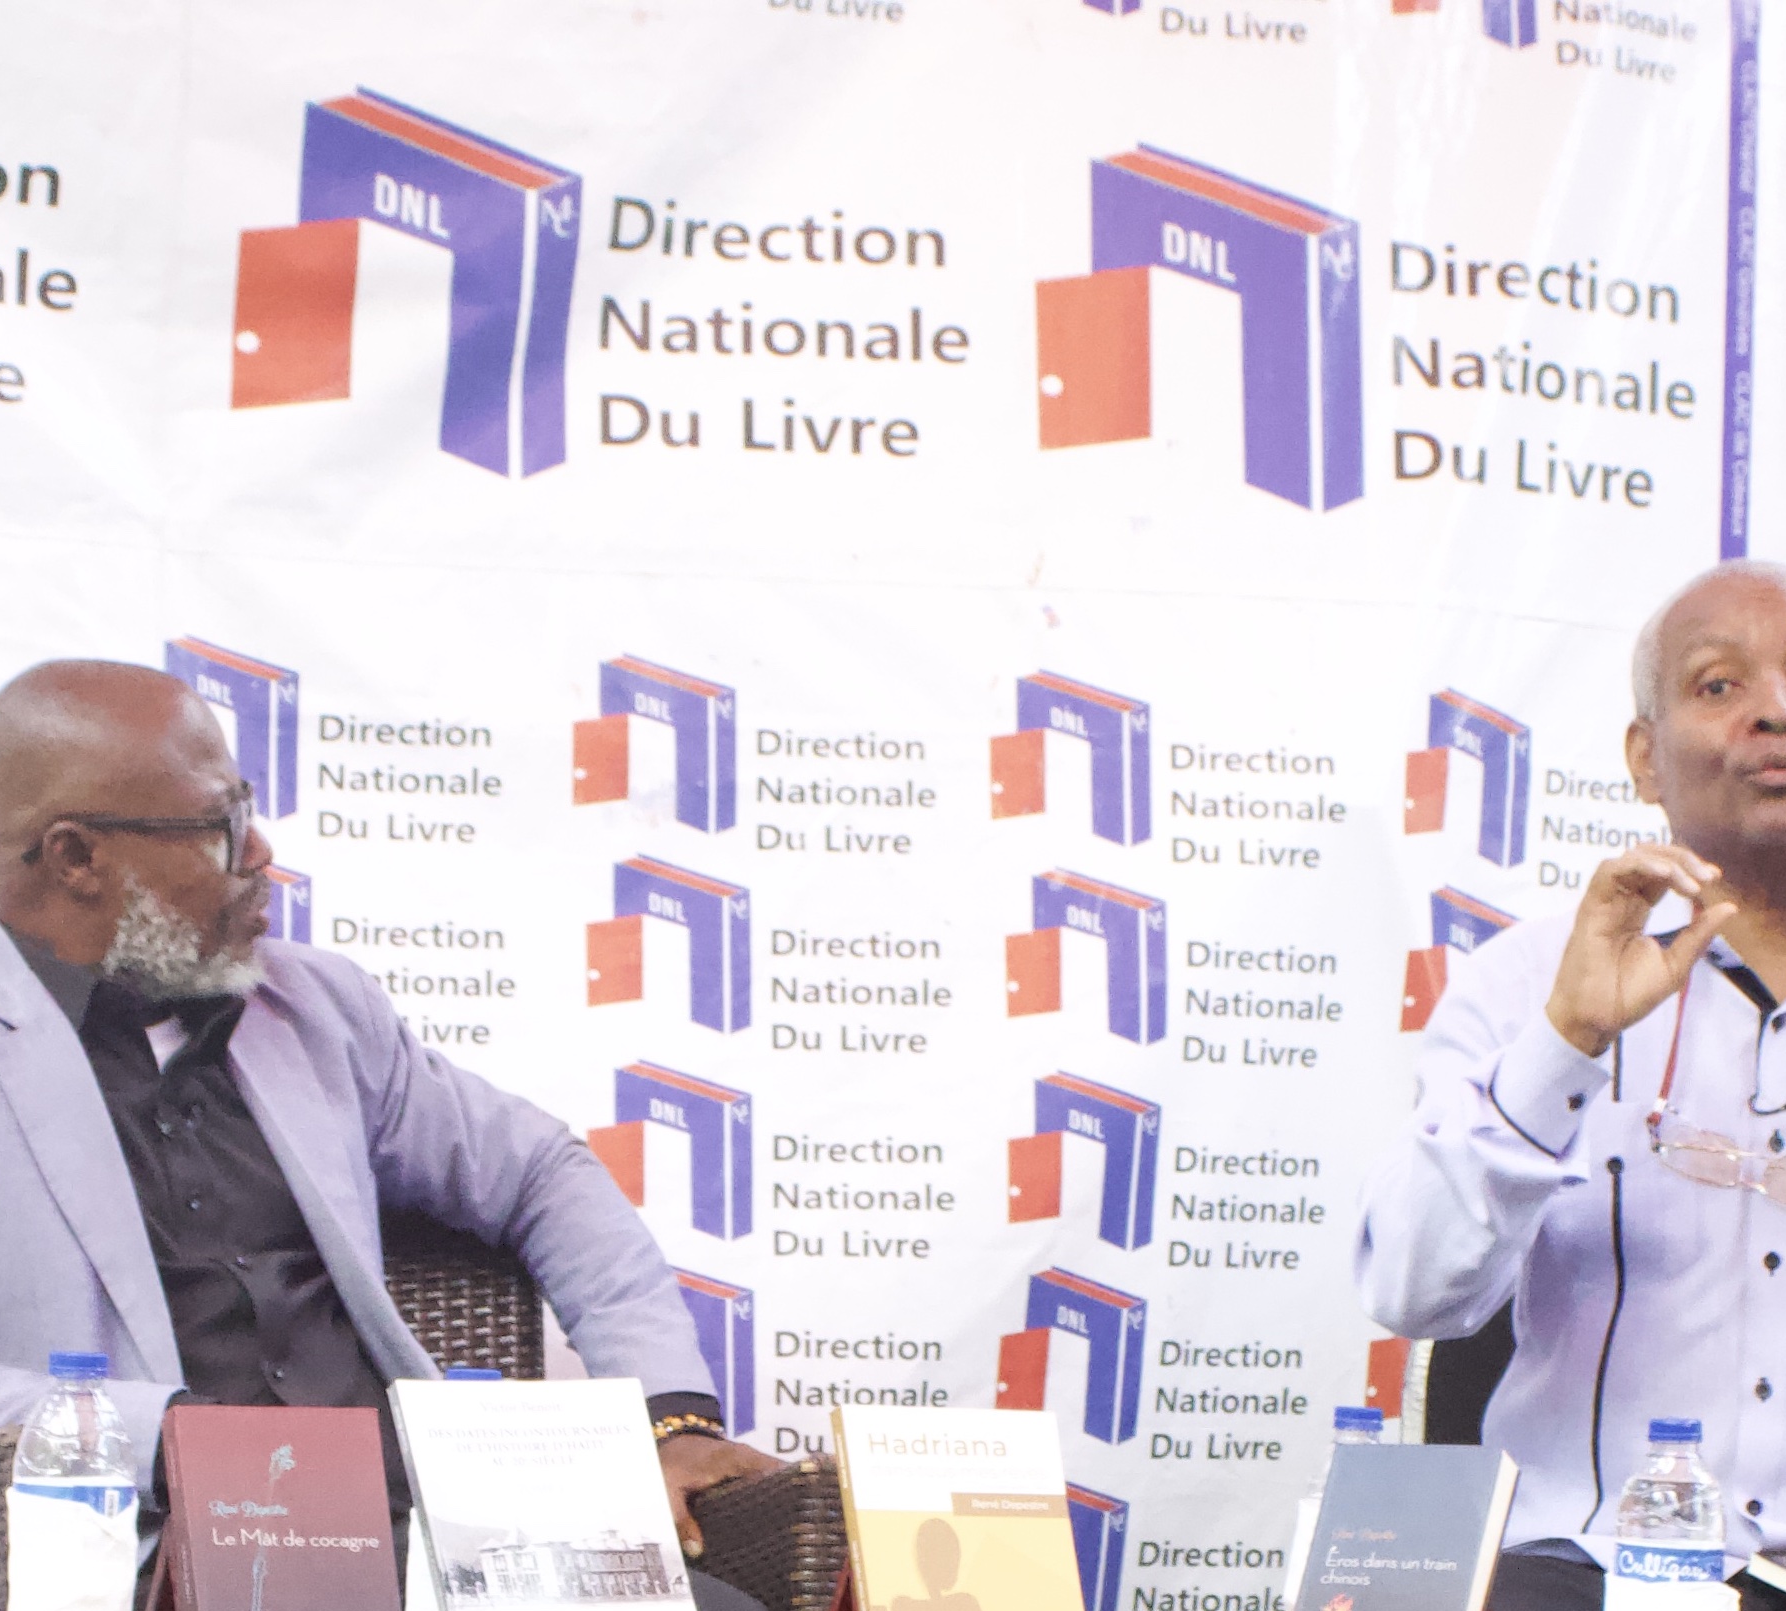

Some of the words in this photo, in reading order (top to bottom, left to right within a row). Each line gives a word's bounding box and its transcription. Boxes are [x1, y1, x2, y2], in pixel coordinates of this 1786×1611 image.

[1159, 6, 1209, 37] Du
[1224, 11, 1308, 44] Livre
[1554, 39, 1602, 67] Du
[1613, 44, 1677, 84] Livre
[373, 172, 452, 240] DNL
[606, 194, 946, 268] Direction
[1161, 221, 1238, 285] DNL
[1390, 240, 1680, 324] Direction
[598, 294, 970, 365] Nationale
[1392, 336, 1697, 421] Nationale
[599, 393, 701, 448] Du
[742, 397, 920, 458] Livre
[1393, 429, 1487, 485] Du
[1515, 438, 1654, 509] Livre
[317, 713, 492, 748] Direction
[755, 728, 926, 761] Direction
[1169, 743, 1336, 776] Direction
[317, 762, 503, 797] Nationale
[755, 776, 937, 809] Nationale
[1170, 789, 1348, 824] Nationale
[317, 810, 369, 840] Du
[386, 813, 477, 844] Livre
[756, 823, 806, 852] Du
[824, 824, 912, 855] Livre
[1171, 836, 1221, 864] Du
[1238, 838, 1322, 870] Livre
[770, 928, 941, 960] Direction
[1186, 940, 1338, 975] Direction
[770, 976, 953, 1008] Nationale
[1185, 987, 1344, 1023] Nationale
[771, 1023, 822, 1052] Du
[840, 1024, 928, 1054] Livre
[1182, 1034, 1227, 1064] Du
[1242, 1037, 1318, 1069] Livre
[772, 1134, 944, 1165] Direction
[1174, 1145, 1321, 1178] Direction
[772, 1181, 956, 1212] Nationale
[1171, 1193, 1326, 1225] Nationale
[772, 1229, 824, 1258] Du
[842, 1229, 931, 1260] Livre
[1167, 1240, 1212, 1269] Du
[1224, 1241, 1301, 1271] Livre
[1158, 1339, 1303, 1369] Direction
[1154, 1386, 1309, 1416] Nationale
[868, 1432, 1008, 1458] Hadriana
[1150, 1432, 1193, 1460] Du
[1206, 1432, 1283, 1462] Livre
[212, 1527, 236, 1546] Le
[240, 1528, 279, 1547] Mât
[283, 1528, 306, 1548] de
[309, 1535, 380, 1553] cocagne
[1137, 1539, 1285, 1569] Direction
[1363, 1553, 1397, 1570] dans
[1401, 1558, 1421, 1570] un
[1424, 1557, 1457, 1571] train
[1319, 1573, 1371, 1586] chinois
